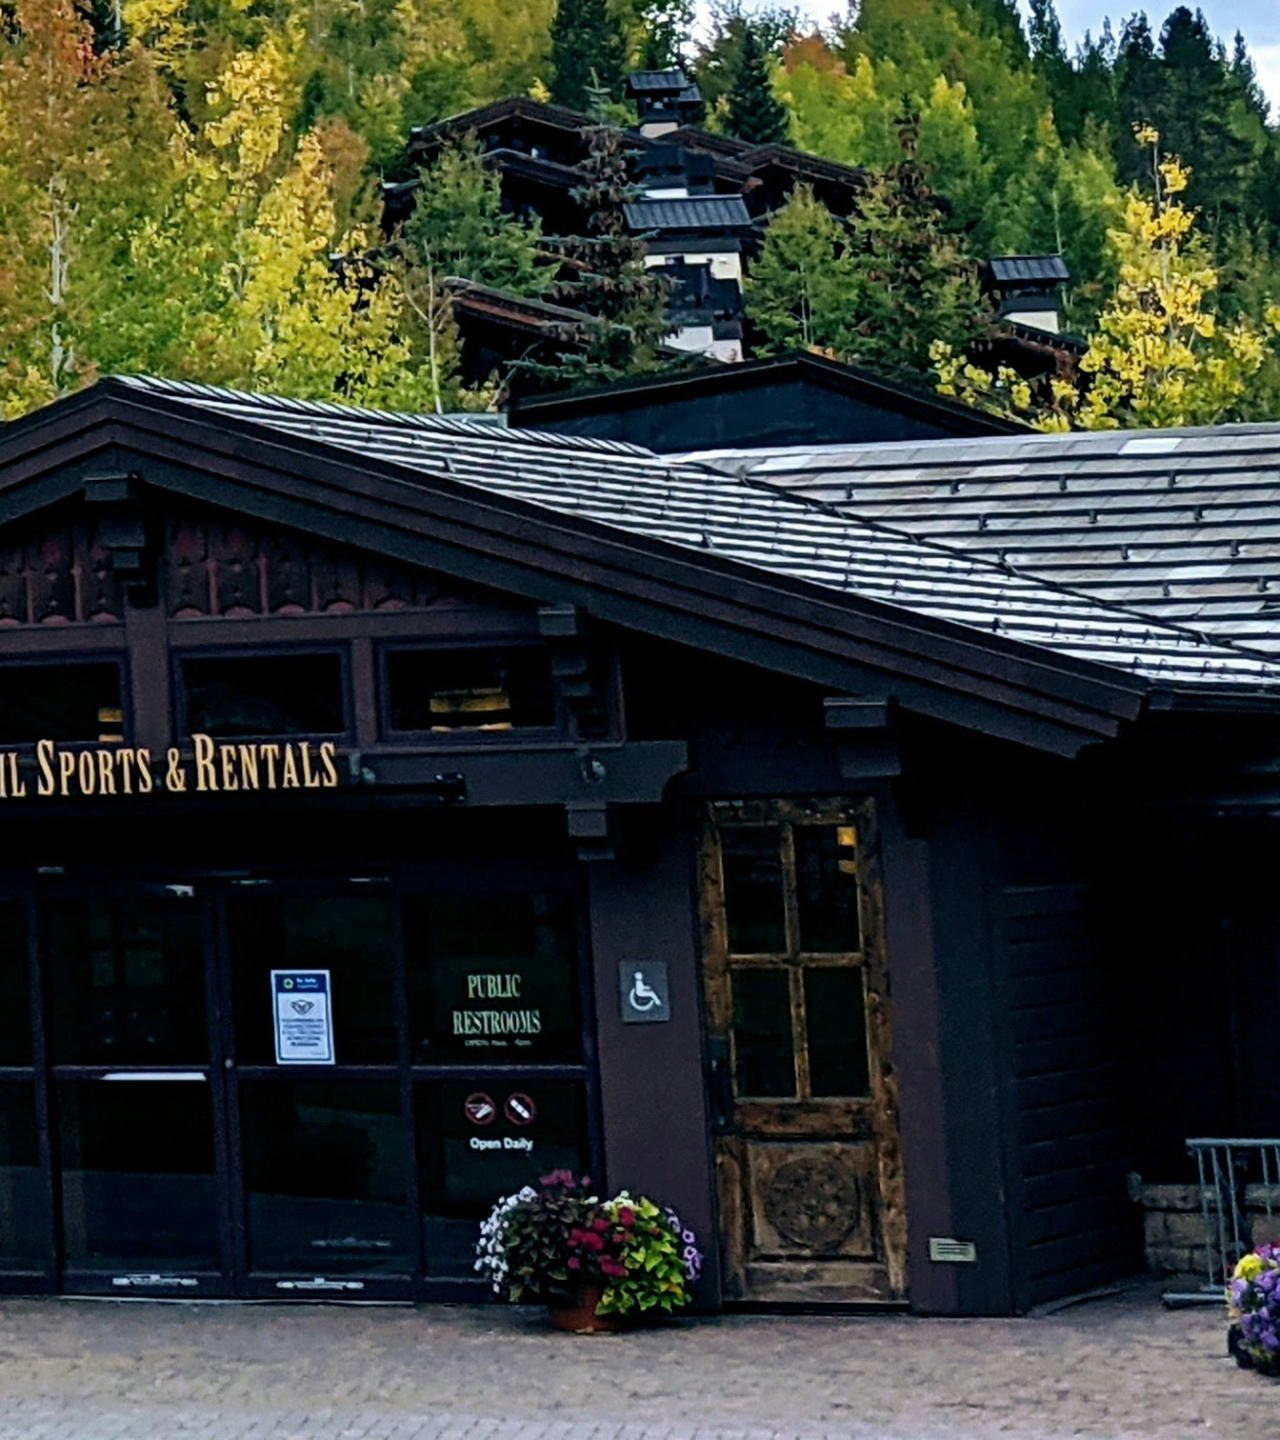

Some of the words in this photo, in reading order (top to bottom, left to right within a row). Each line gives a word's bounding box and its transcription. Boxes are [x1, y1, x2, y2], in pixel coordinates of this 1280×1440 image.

[37, 739, 153, 796] SPORTS
[165, 747, 186, 792] &
[192, 733, 339, 791] RENTALS
[467, 974, 521, 999] PUBLIC
[452, 1009, 542, 1035] RESTROOMS
[469, 1136, 502, 1152] Open
[503, 1136, 534, 1156] Daily
